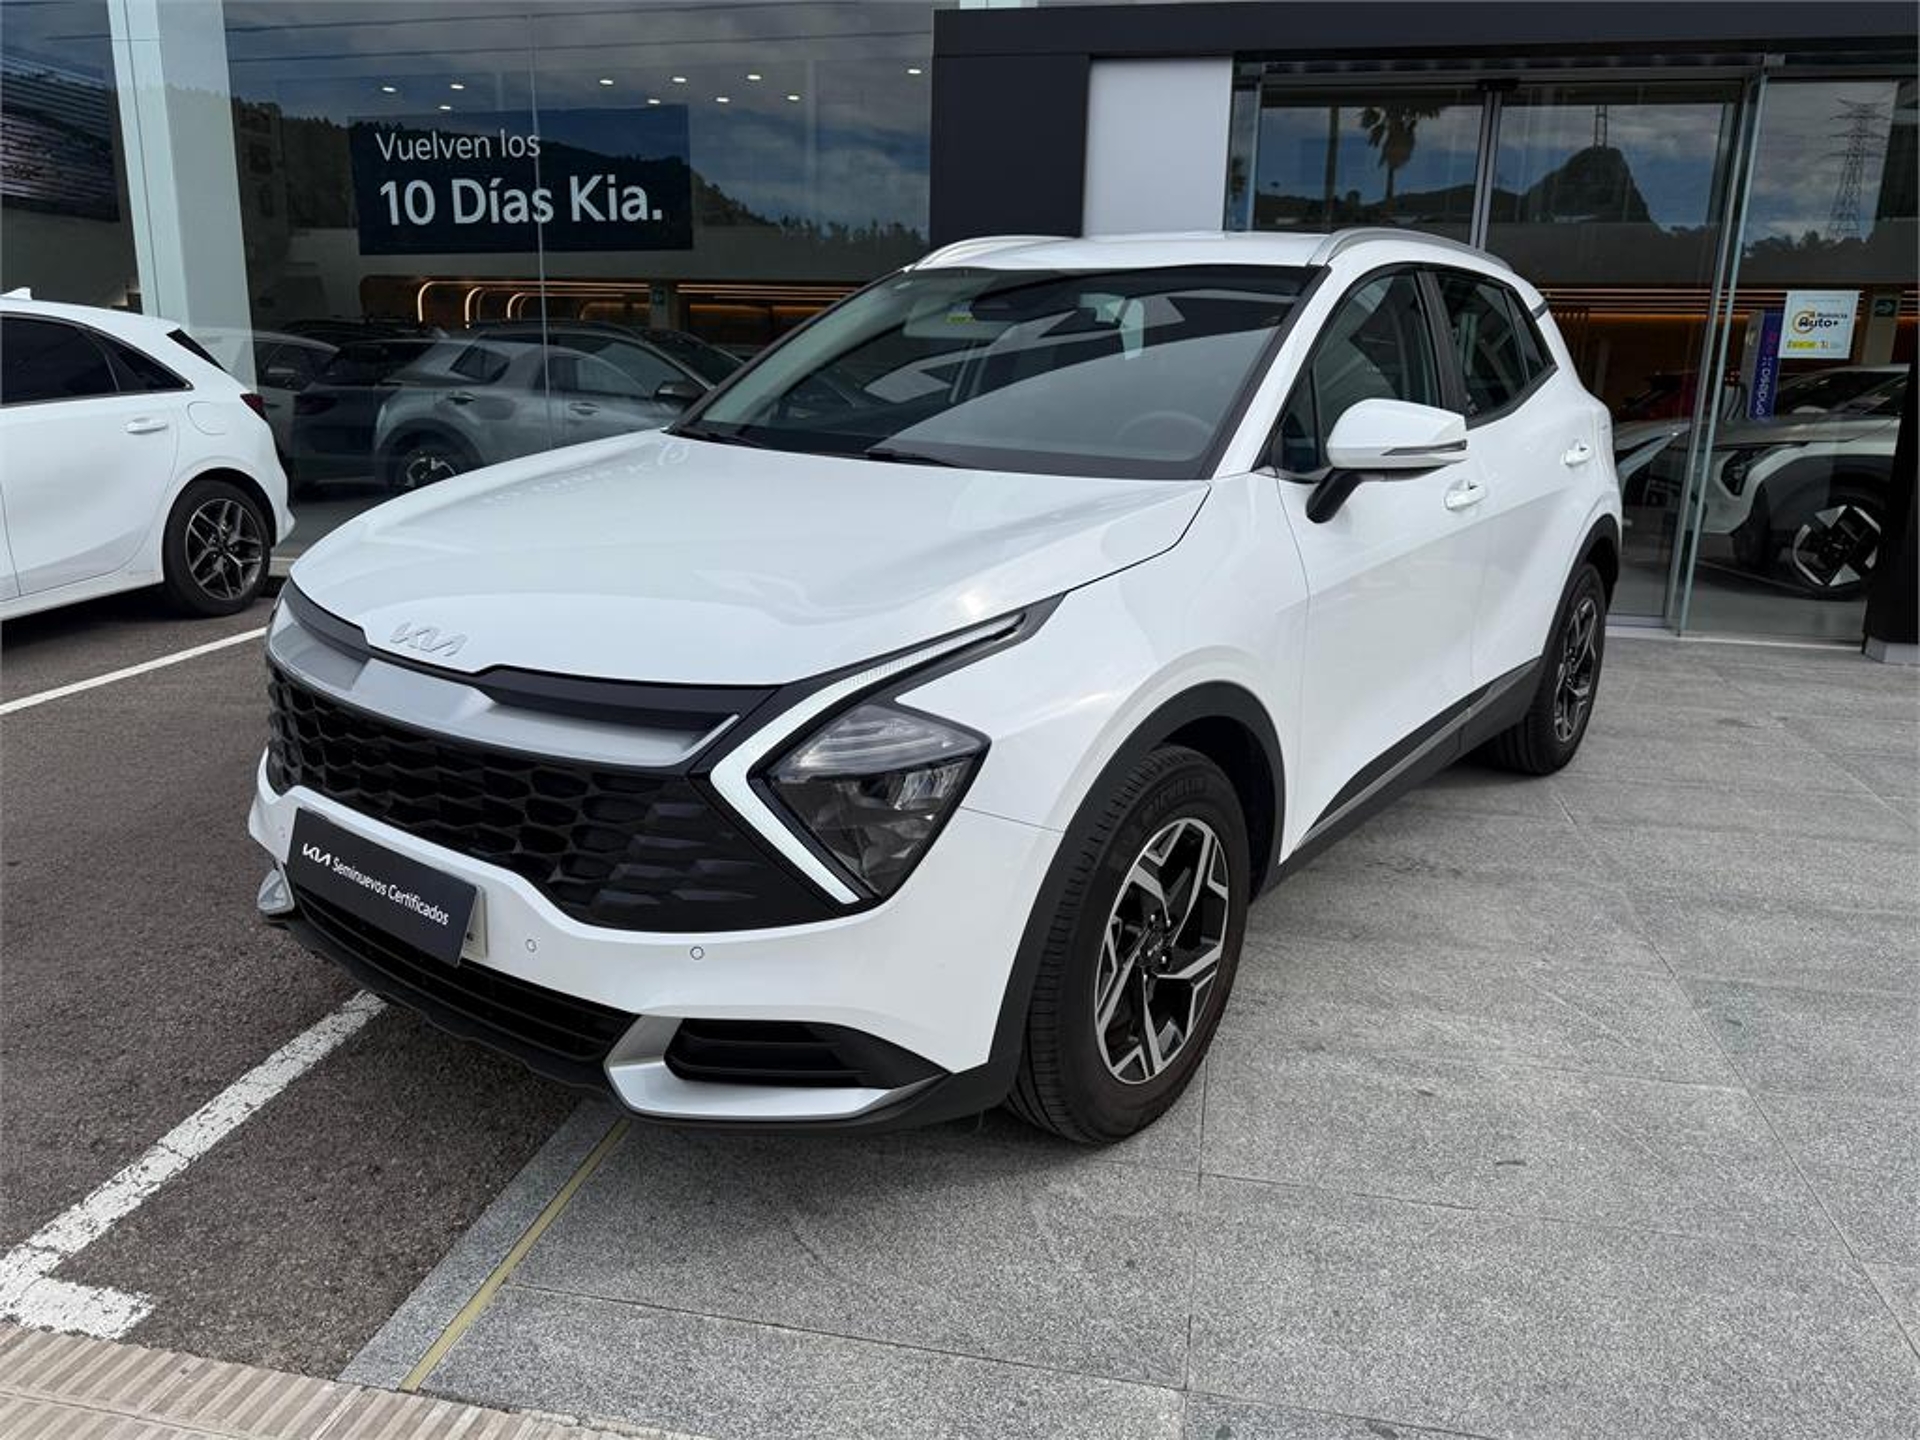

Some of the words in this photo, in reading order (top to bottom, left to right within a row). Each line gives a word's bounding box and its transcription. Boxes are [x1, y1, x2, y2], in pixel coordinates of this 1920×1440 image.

[375, 130, 491, 162] Vuelven
[500, 128, 541, 159] los
[379, 179, 436, 226] 10
[451, 178, 554, 225] Días
[569, 174, 663, 223] Kia.
[390, 622, 467, 657] KIA
[302, 843, 331, 866] KIA
[333, 857, 387, 896] Seminuevos
[388, 884, 449, 926] Certificados
